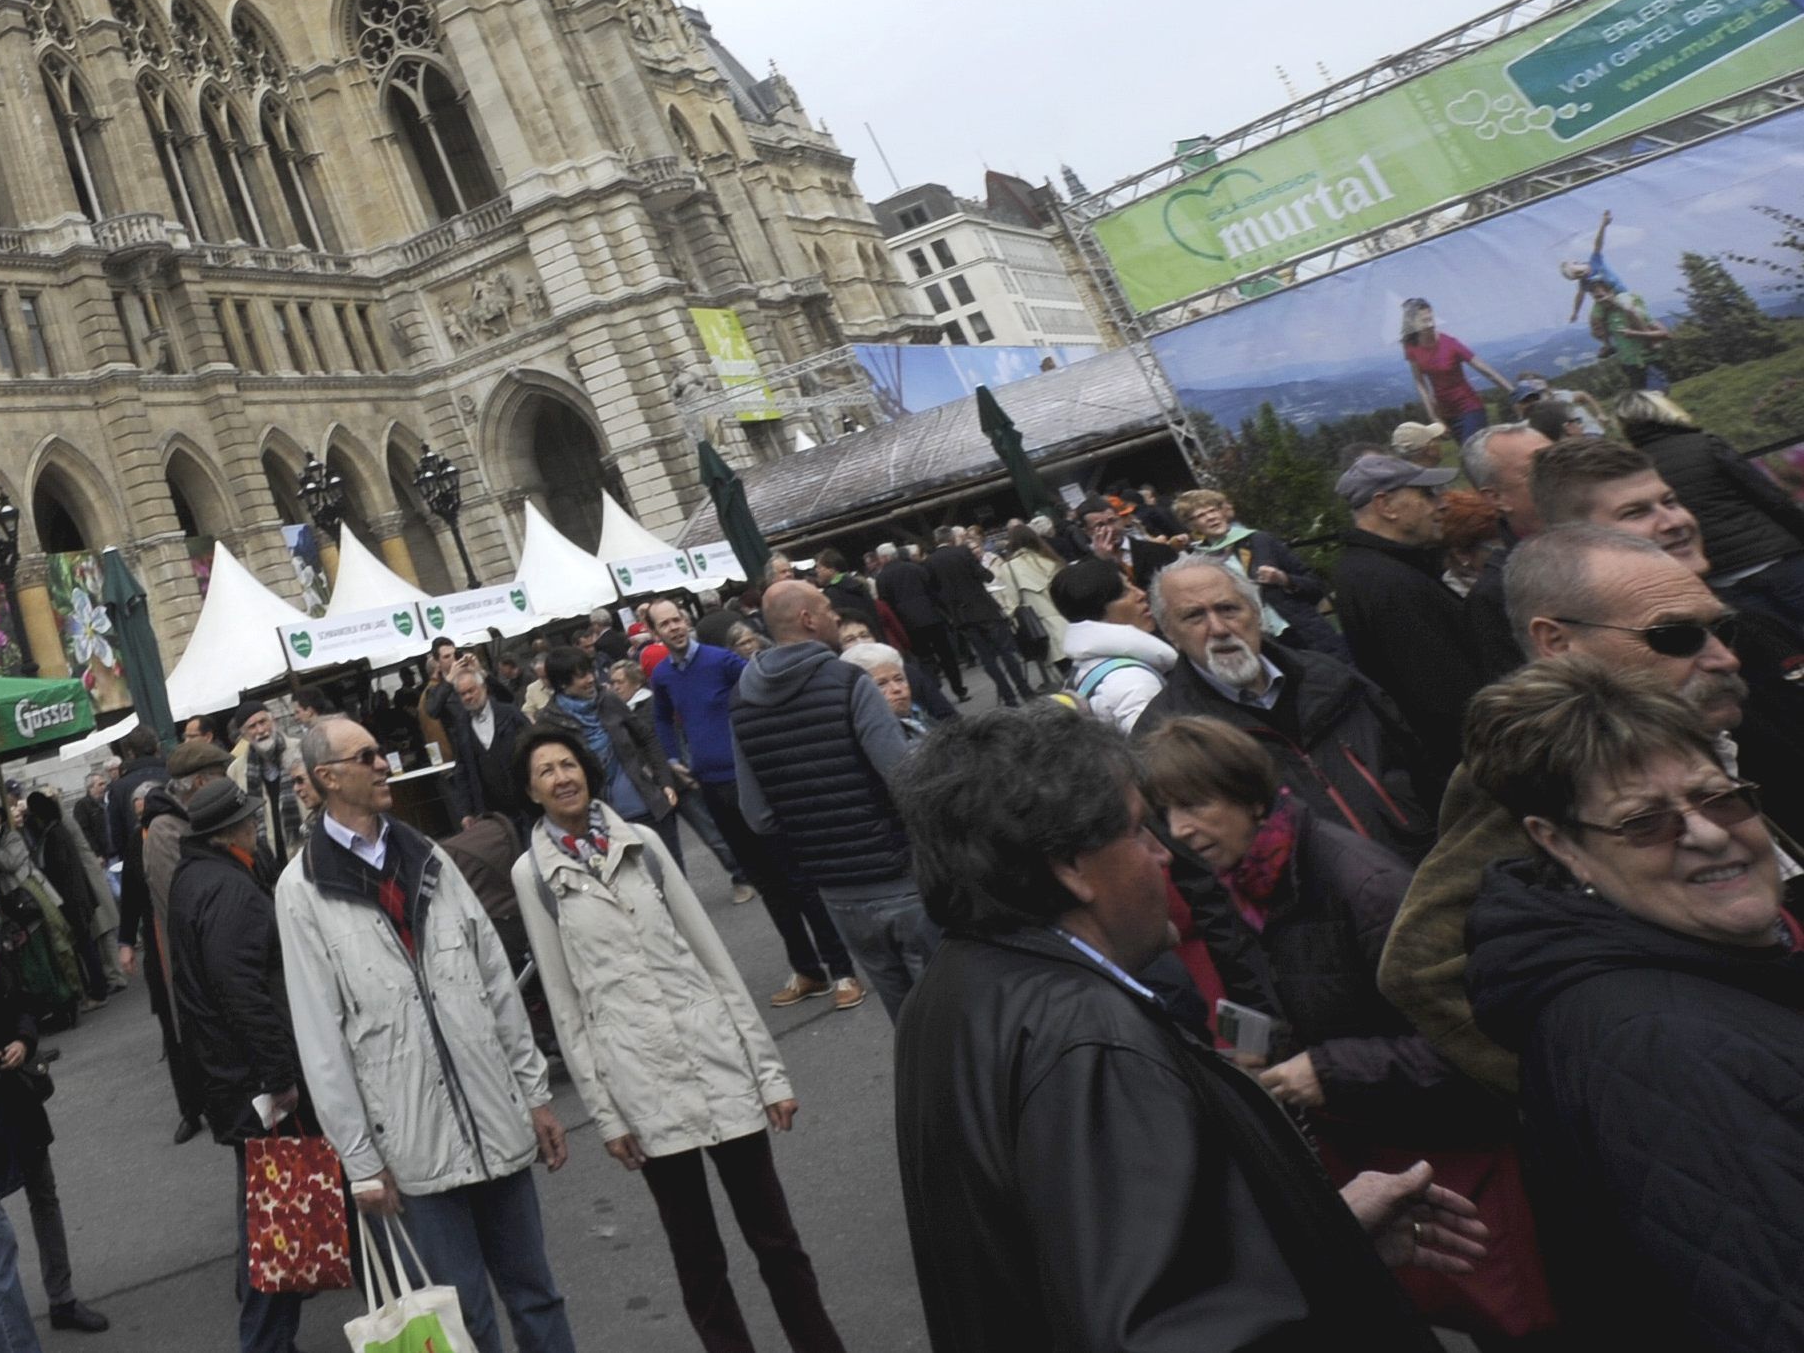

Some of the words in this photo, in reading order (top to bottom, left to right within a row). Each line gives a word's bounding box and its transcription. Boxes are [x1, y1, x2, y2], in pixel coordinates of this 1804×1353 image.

[1558, 62, 1611, 94] VOM
[1610, 23, 1686, 68] GIPFEL
[1218, 154, 1396, 258] murtal
[15, 699, 74, 738] Gösser
